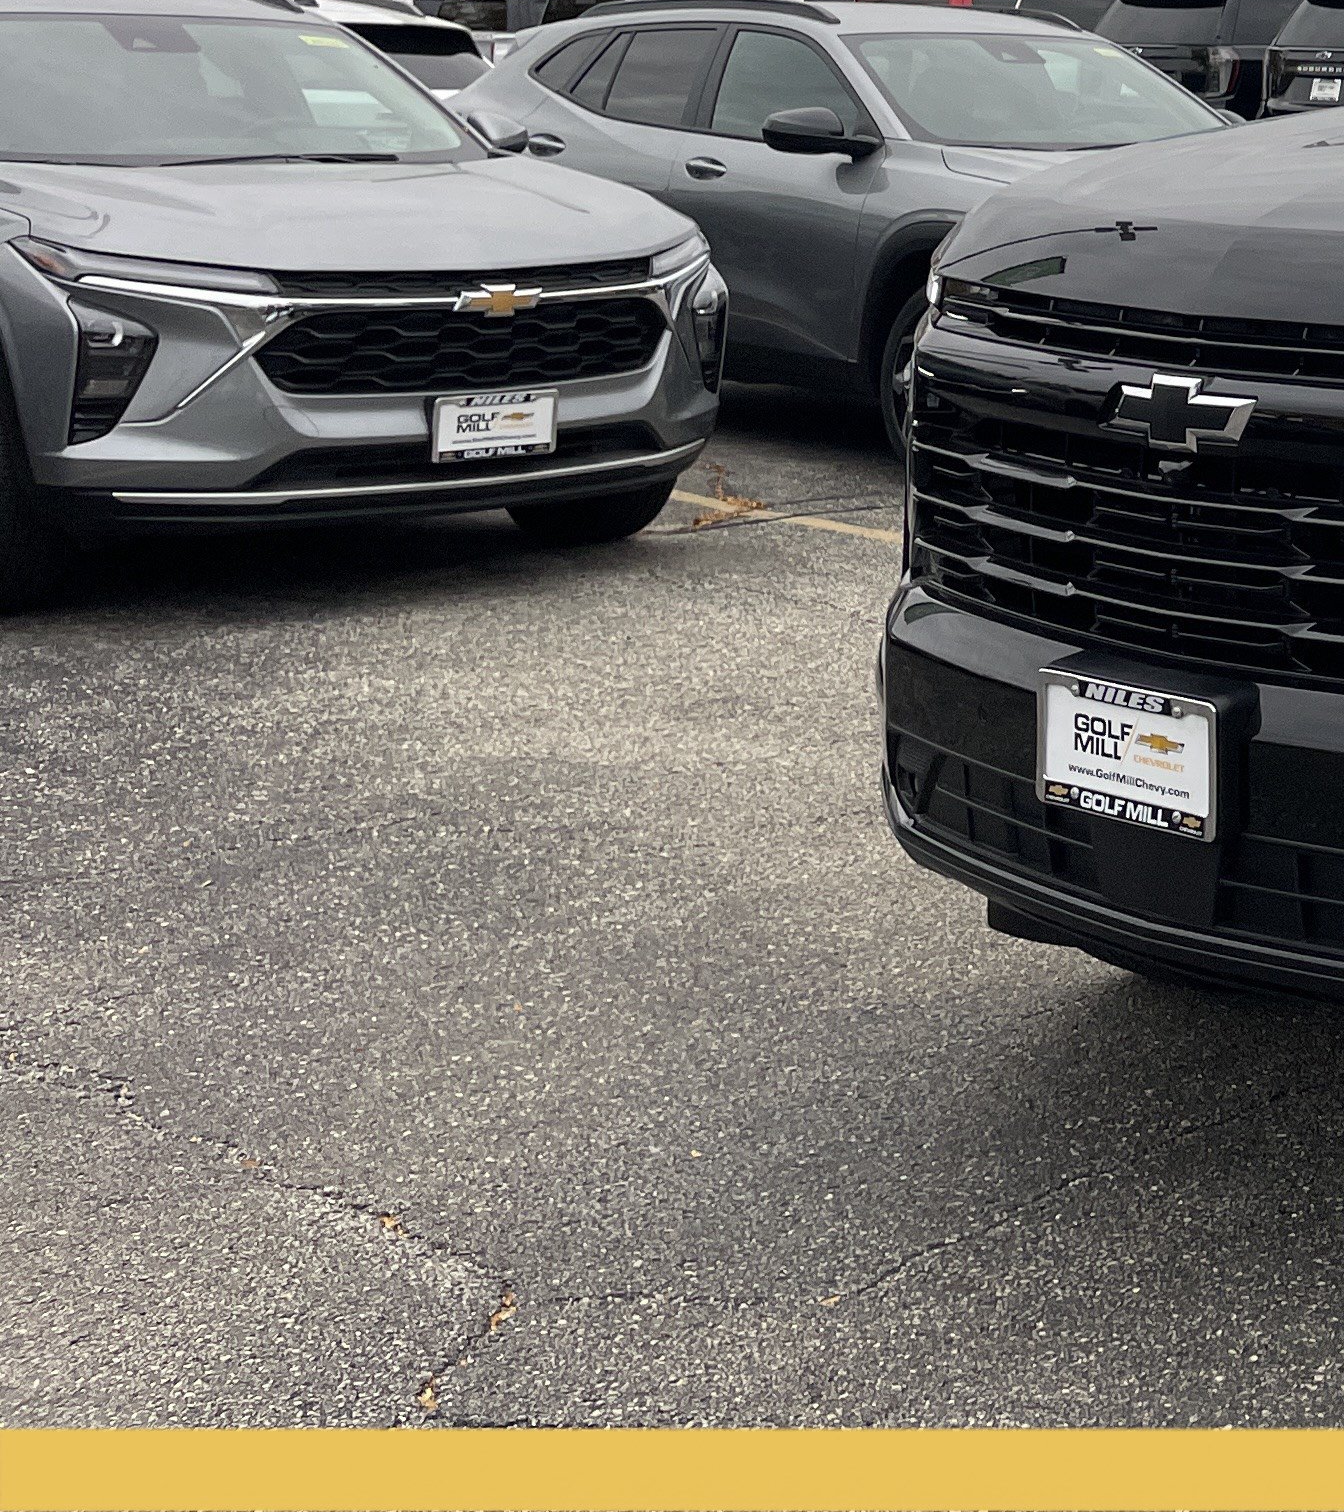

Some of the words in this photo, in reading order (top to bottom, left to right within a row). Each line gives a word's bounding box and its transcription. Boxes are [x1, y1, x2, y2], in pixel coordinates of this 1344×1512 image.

[456, 422, 492, 434] MILL
[457, 412, 500, 426] GOLF
[1084, 683, 1165, 714] NILES
[1074, 713, 1134, 743] GOLF
[1074, 733, 1122, 761] MILL
[1068, 762, 1190, 800] www.GolfMillChevy.com
[1080, 791, 1126, 816] GOLF
[1125, 801, 1169, 828] MILL
